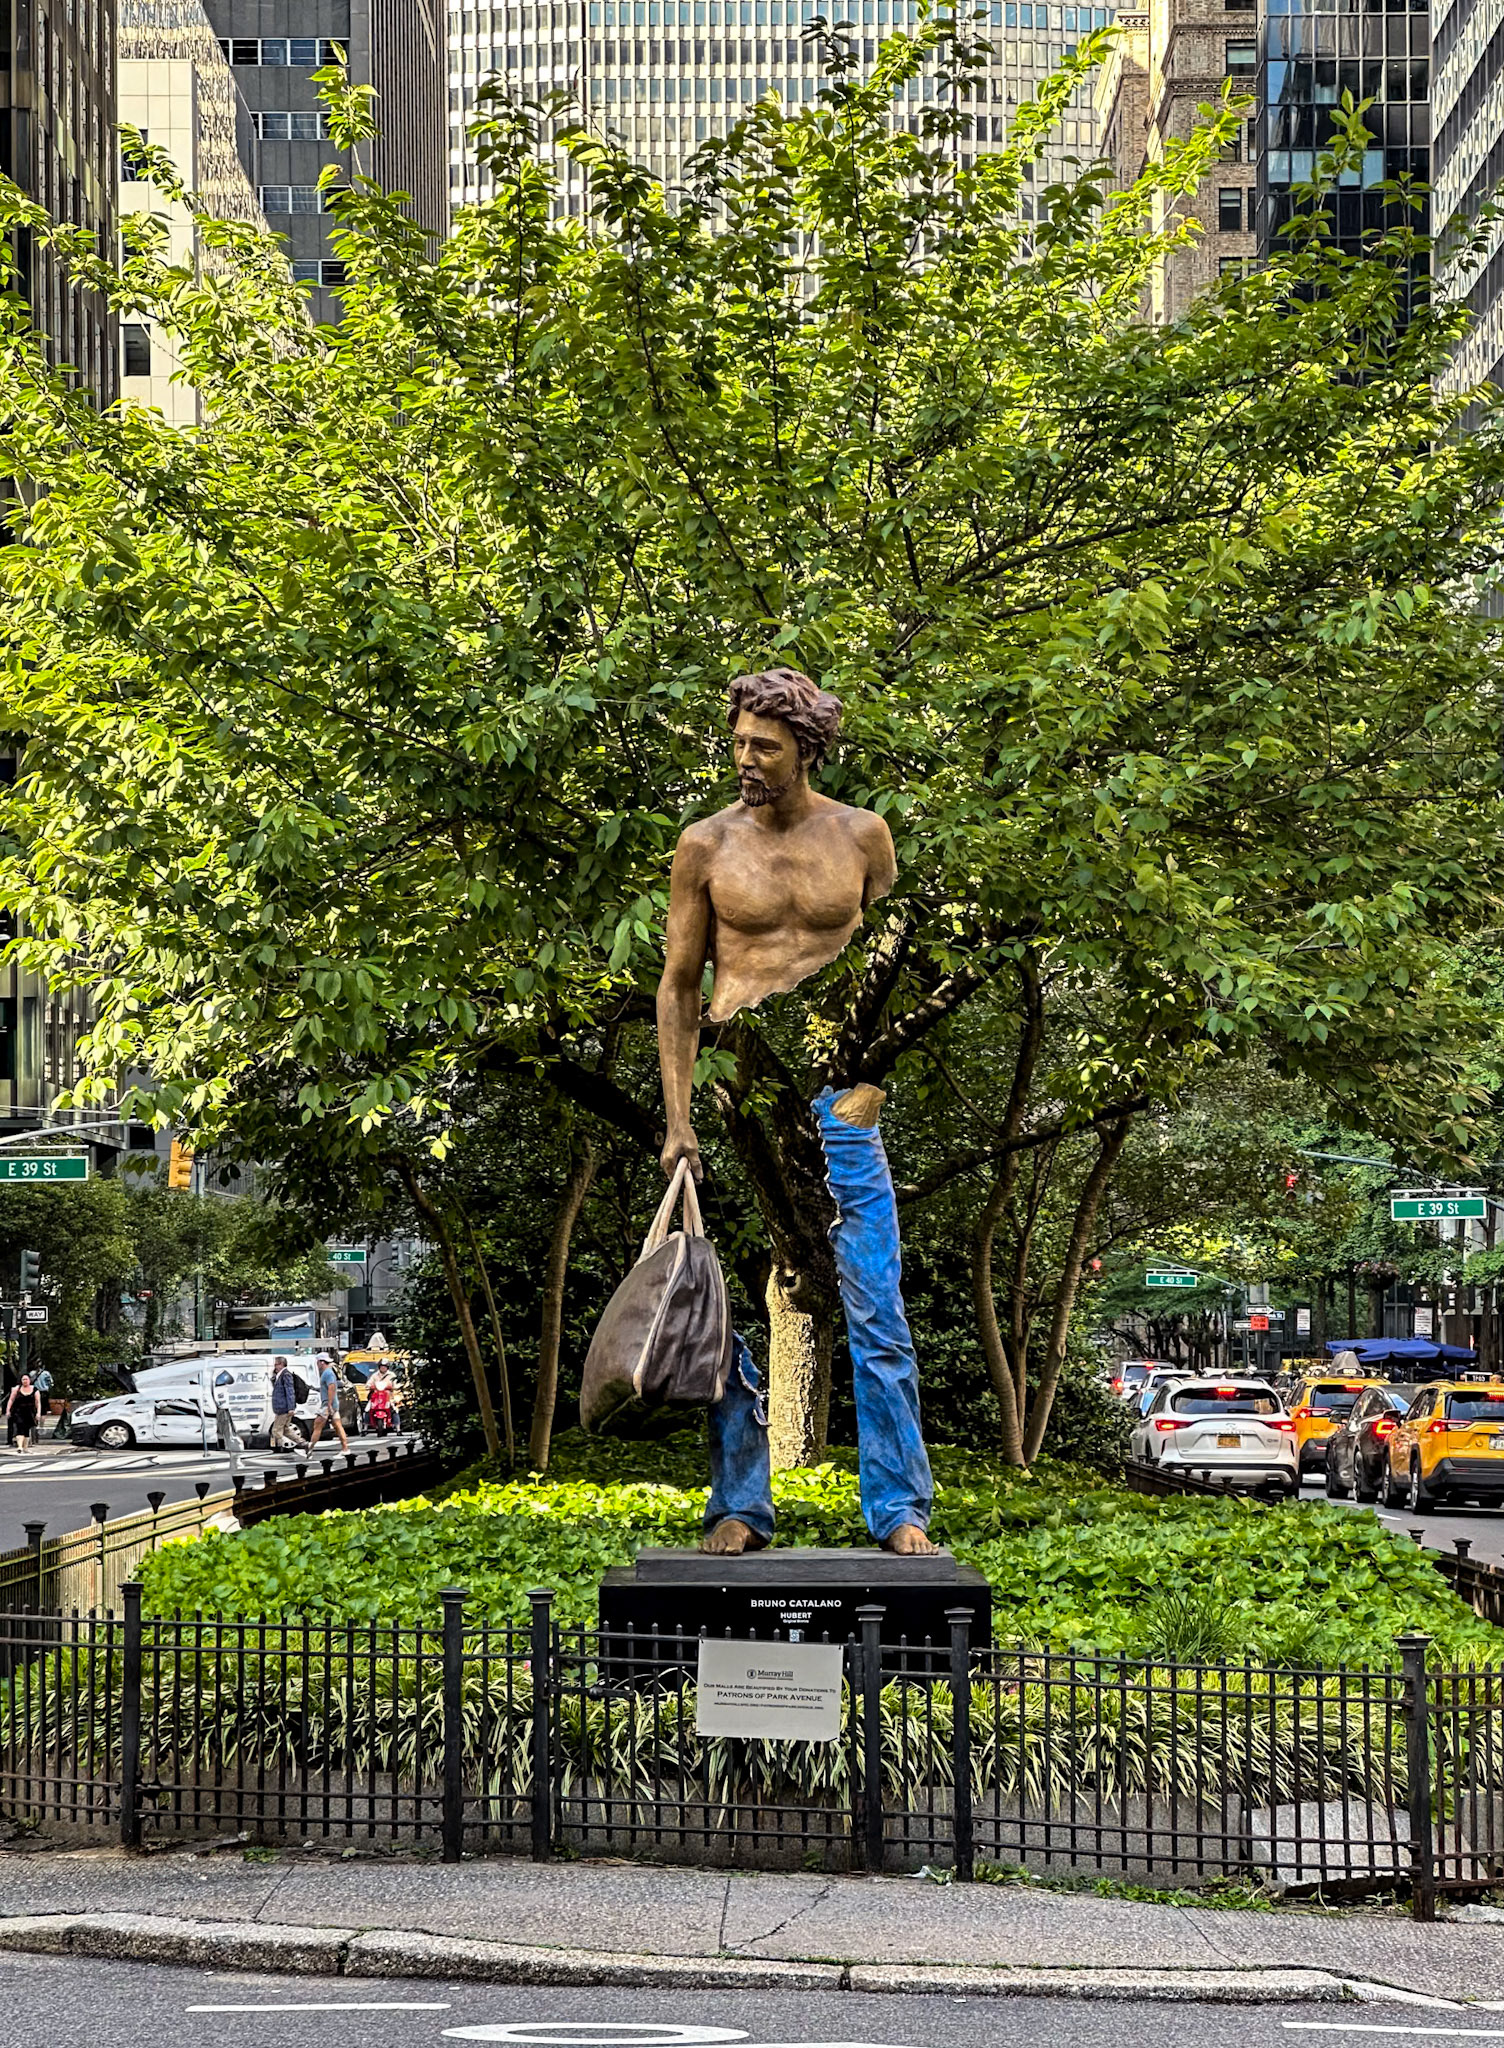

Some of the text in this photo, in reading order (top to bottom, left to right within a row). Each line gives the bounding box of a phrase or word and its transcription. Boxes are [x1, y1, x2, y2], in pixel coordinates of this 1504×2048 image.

[8, 1161, 57, 1177] E 39 St
[1417, 1202, 1460, 1216] E 39 St
[332, 1252, 342, 1261] 40
[343, 1252, 351, 1261] St
[1159, 1276, 1183, 1285] E 40 St
[750, 1599, 842, 1608] BRUNO CATALANO
[780, 1611, 812, 1619] HUBERT
[757, 1669, 794, 1678] Murray Hill
[717, 1691, 754, 1699] PATRONS
[790, 1694, 822, 1702] AVENUE
